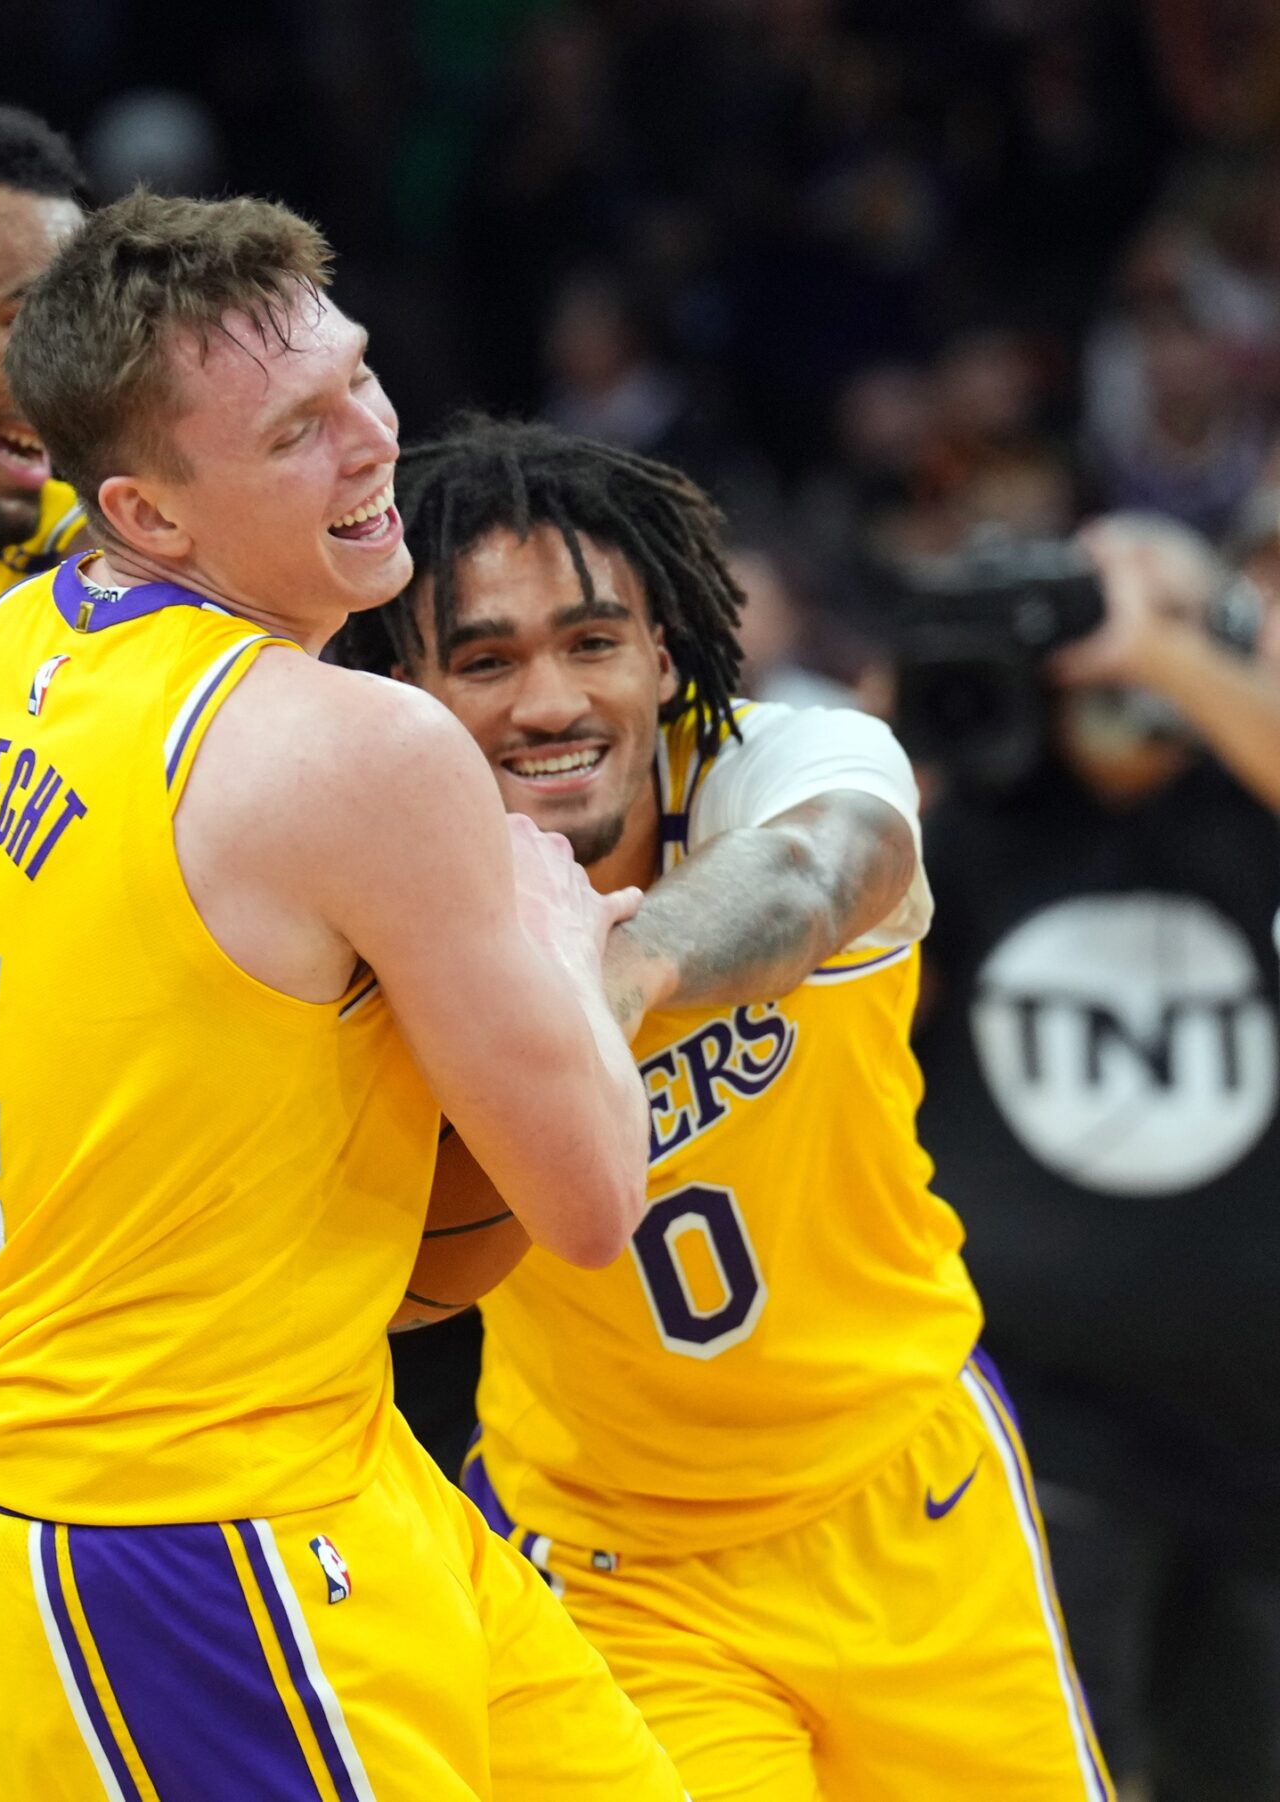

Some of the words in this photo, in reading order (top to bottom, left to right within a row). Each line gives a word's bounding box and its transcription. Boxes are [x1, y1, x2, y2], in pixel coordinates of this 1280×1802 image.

[635, 1000, 798, 1168] ERS
[978, 988, 1270, 1093] TNT
[629, 1180, 769, 1360] 0
